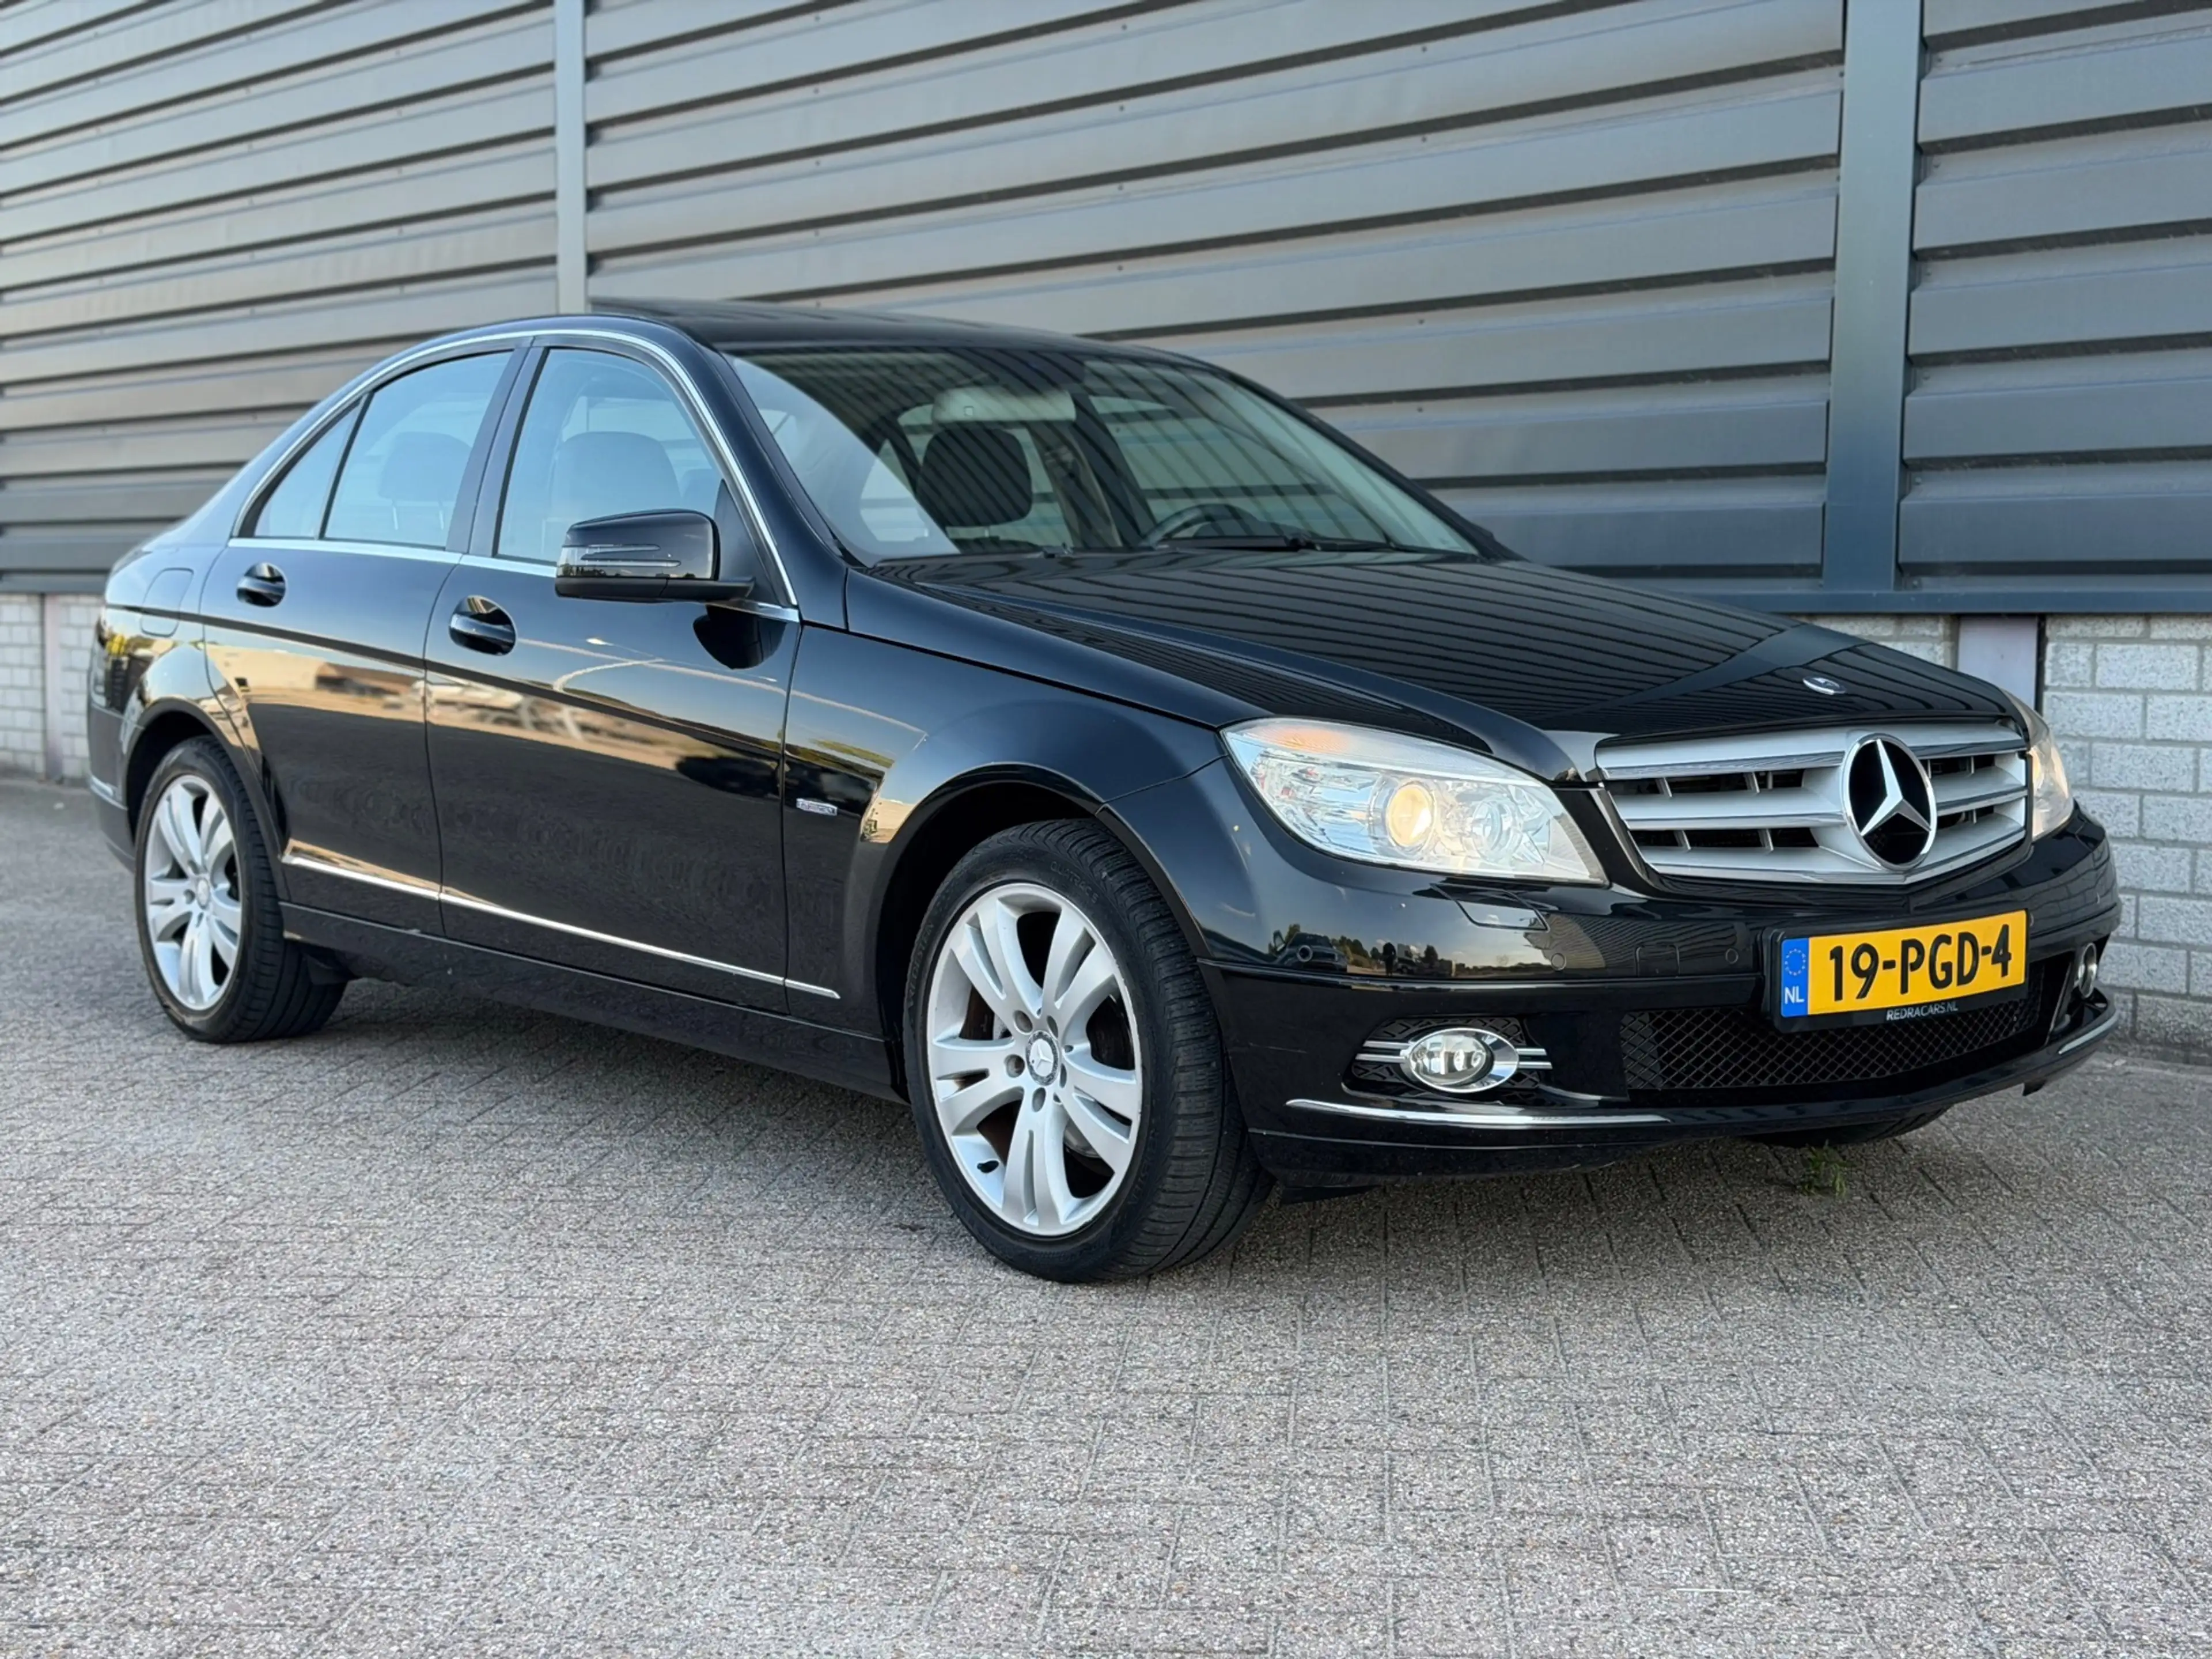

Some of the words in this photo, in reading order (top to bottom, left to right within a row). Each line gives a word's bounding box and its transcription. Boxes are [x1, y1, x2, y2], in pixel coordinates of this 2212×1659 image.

[1830, 924, 2012, 1002] 19-PGD-4
[1785, 986, 1805, 1004] NL
[1886, 1001, 1959, 1021] REDRACARS.NL
